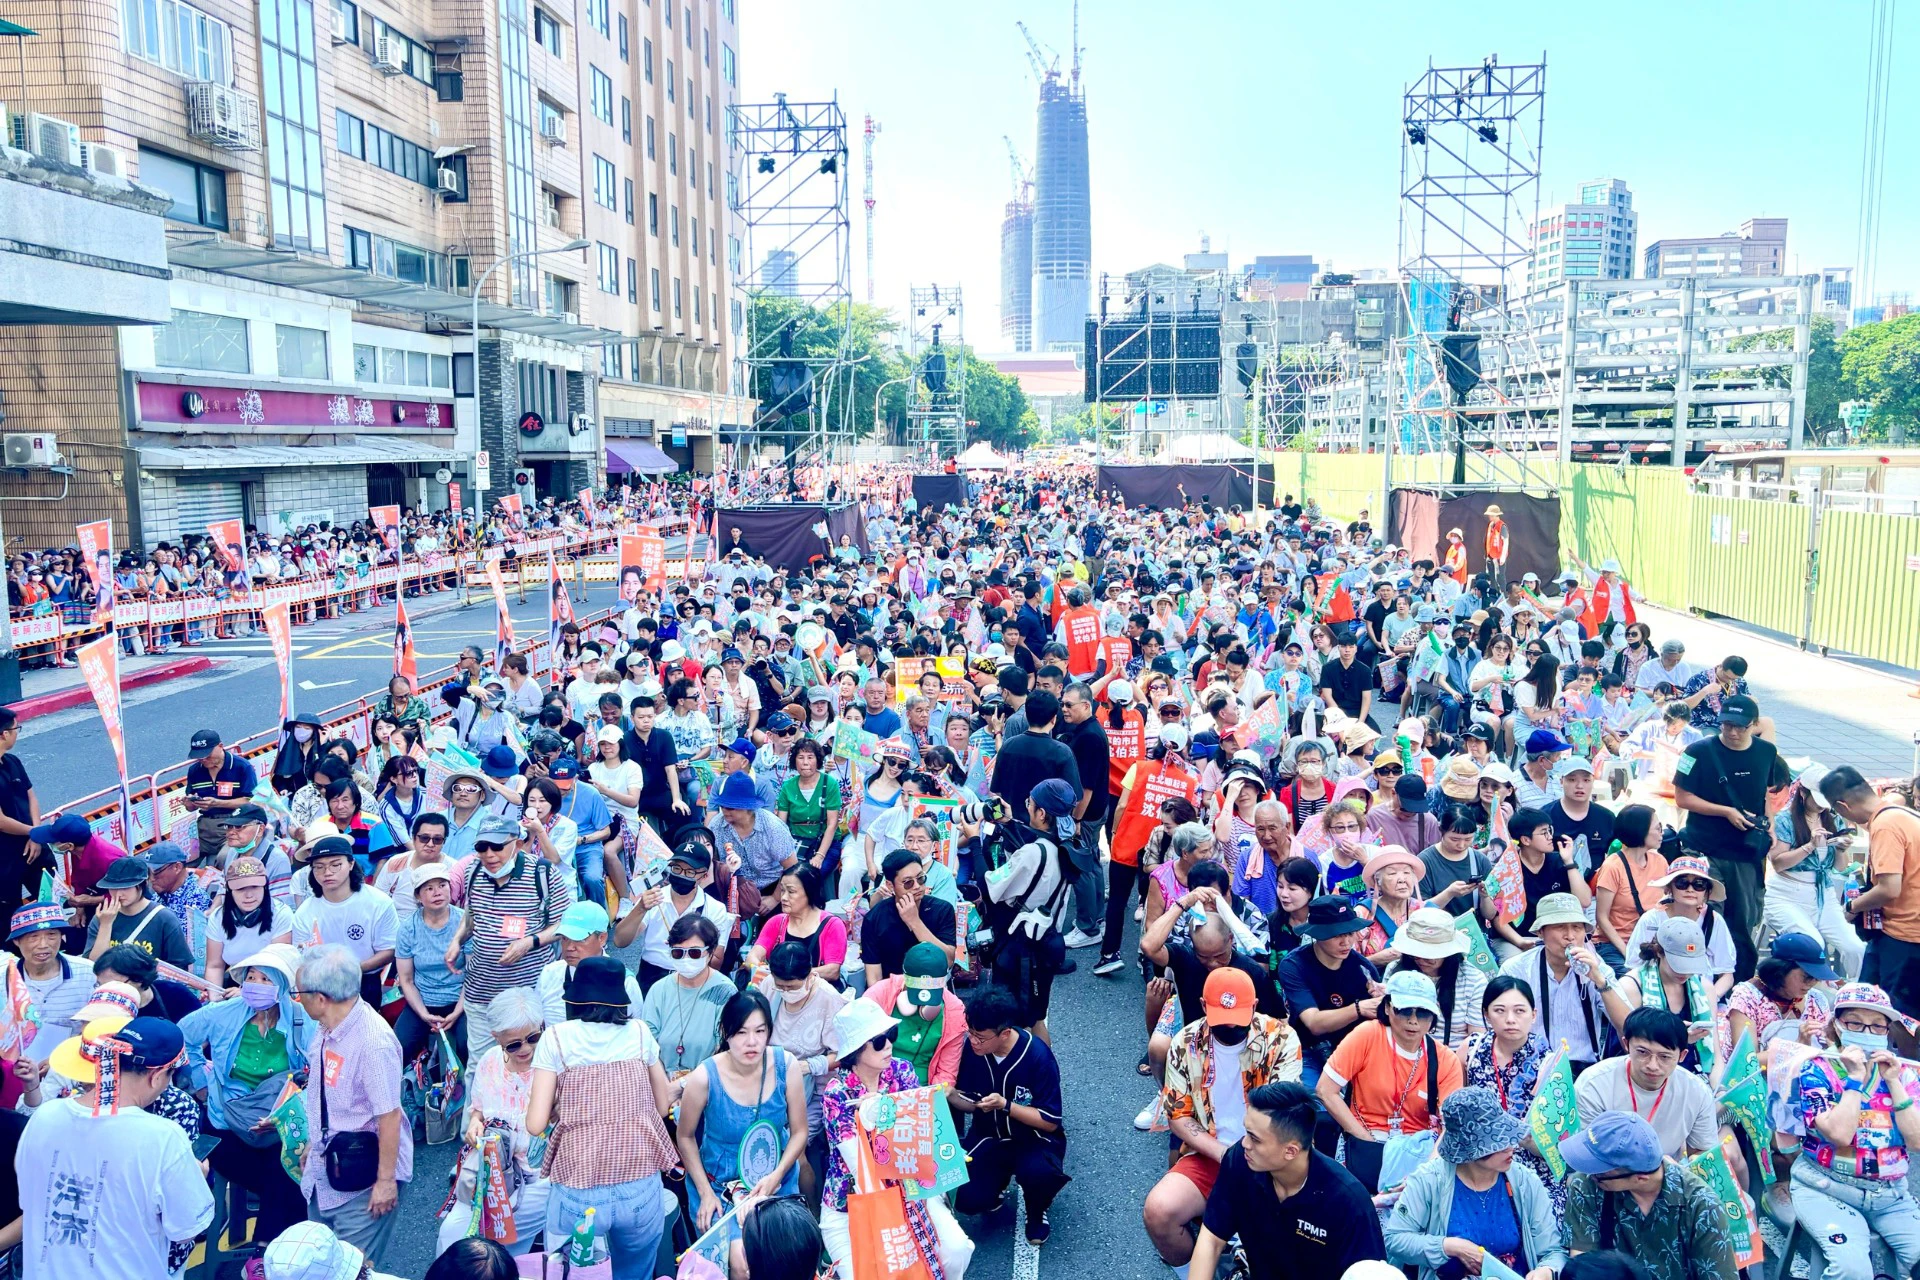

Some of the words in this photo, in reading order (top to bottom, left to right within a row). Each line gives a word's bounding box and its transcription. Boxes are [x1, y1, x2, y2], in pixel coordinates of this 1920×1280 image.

[11, 621, 53, 637] 車輛改道
[48, 1171, 94, 1249] 洋流
[1297, 1218, 1328, 1238] TPMP
